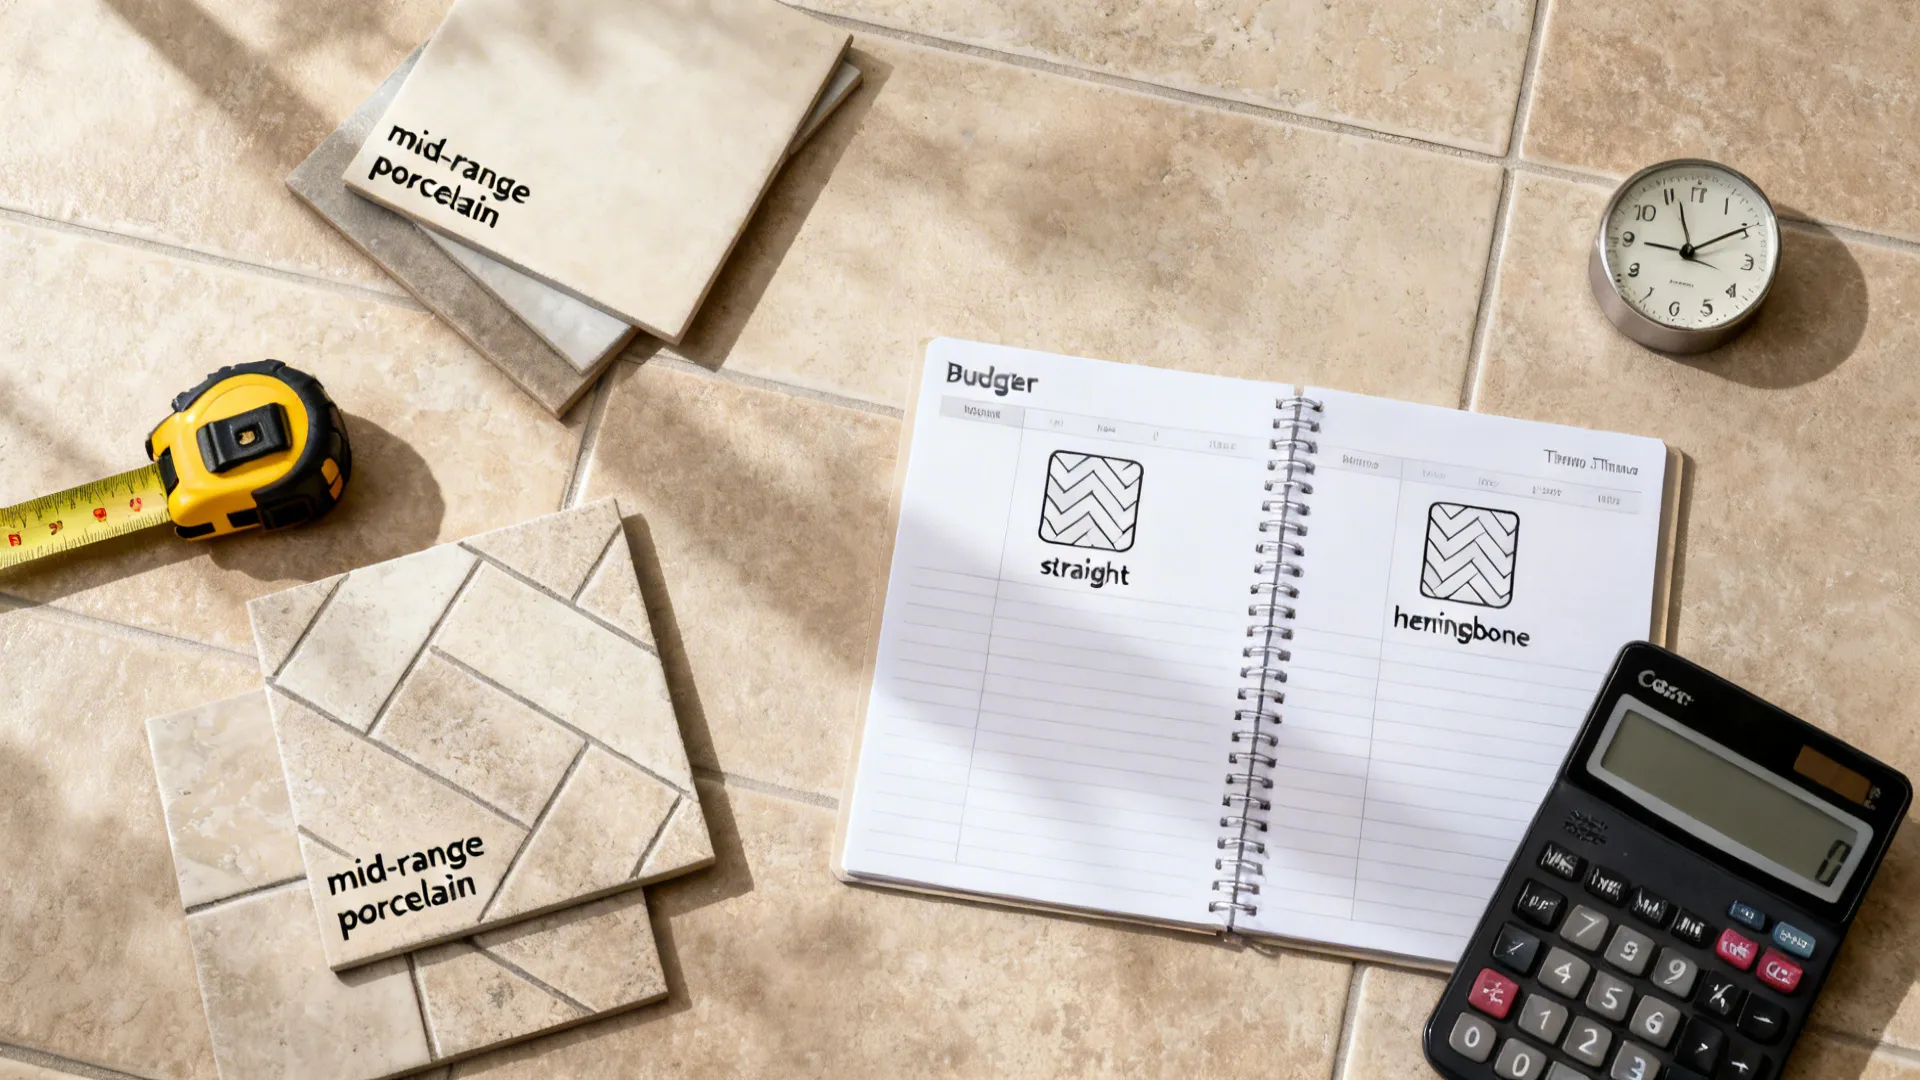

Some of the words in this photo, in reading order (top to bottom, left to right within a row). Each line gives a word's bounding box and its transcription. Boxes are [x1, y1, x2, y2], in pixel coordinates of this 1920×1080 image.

[387, 125, 531, 204] mid-range
[368, 156, 500, 229] porcelain
[1634, 204, 1657, 222] 10
[1622, 231, 1636, 248] 9
[1700, 298, 1713, 317] 5
[1040, 557, 1130, 589] straight
[327, 836, 485, 896] mid-range
[1814, 839, 1852, 888] 0
[337, 874, 477, 941] porcelain
[1580, 912, 1600, 937] 7
[1554, 962, 1572, 984] 4
[1663, 959, 1686, 985] 9
[1601, 987, 1623, 1010] 5
[1539, 1010, 1551, 1031] 1
[1645, 1011, 1664, 1035] 6
[1464, 1026, 1481, 1048] 0
[1578, 1028, 1598, 1056] 2
[1512, 1052, 1530, 1077] 0
